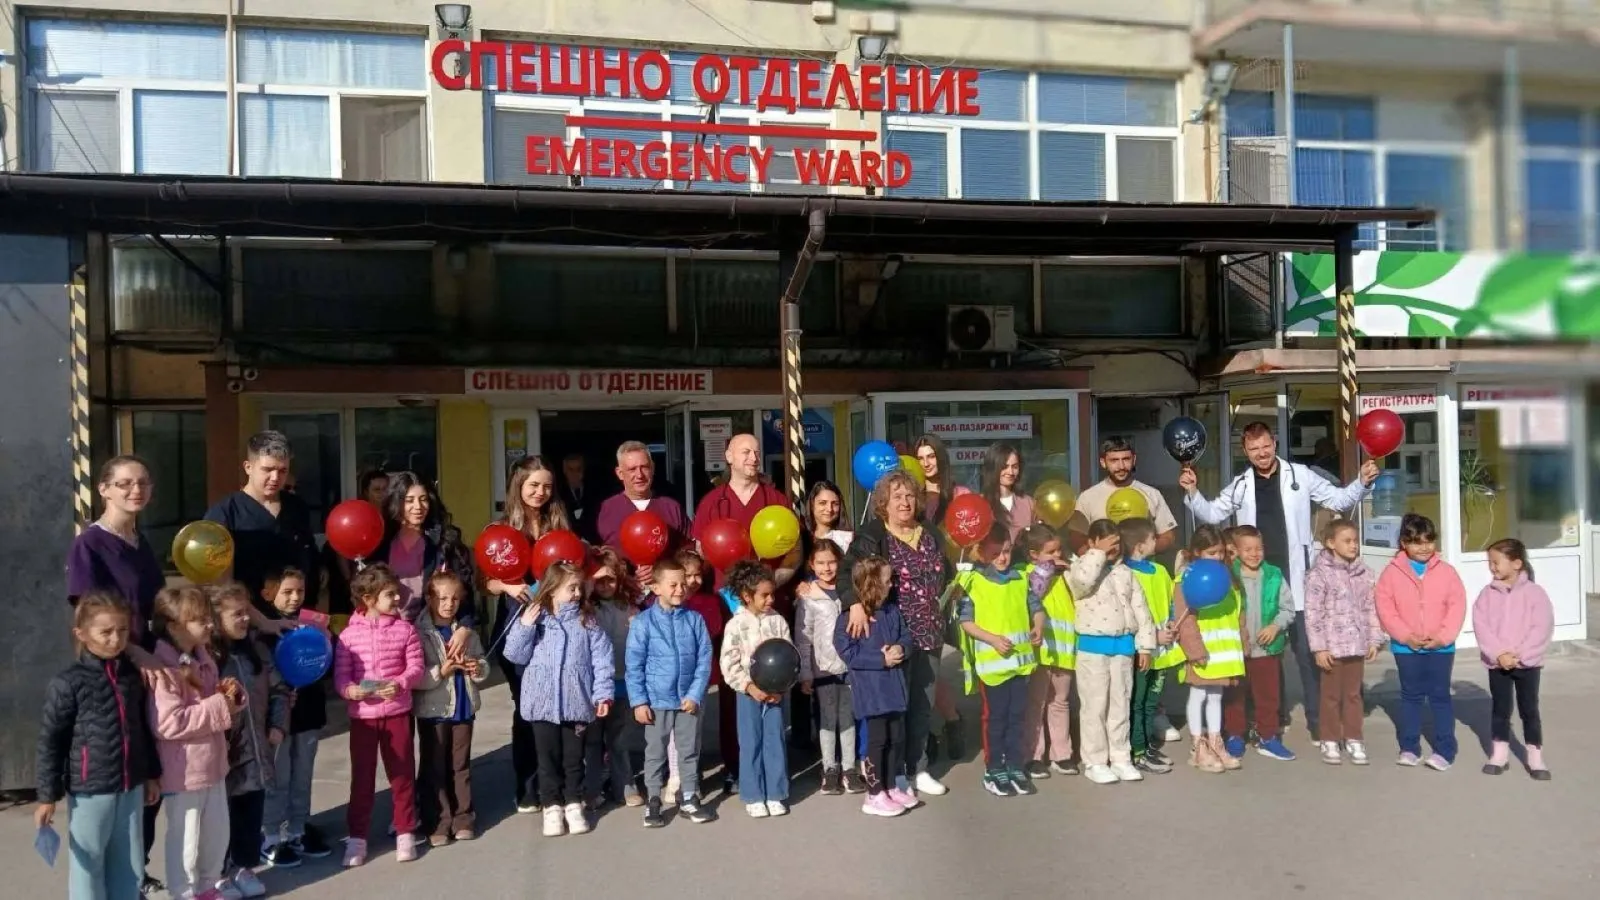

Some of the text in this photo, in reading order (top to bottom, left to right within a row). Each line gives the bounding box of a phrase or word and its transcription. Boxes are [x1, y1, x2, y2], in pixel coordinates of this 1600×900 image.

[431, 39, 981, 116] СПЕШНО ОТДЕЛЕНИЕ
[526, 136, 912, 188] EMERGENCY WARD
[472, 370, 706, 394] СПЕШНО ОТДЕЛЕНИЕ
[1362, 393, 1435, 409] РЕГИСТРАТУРА
[1017, 423, 1028, 432] АД
[956, 450, 986, 461] ОХРА
